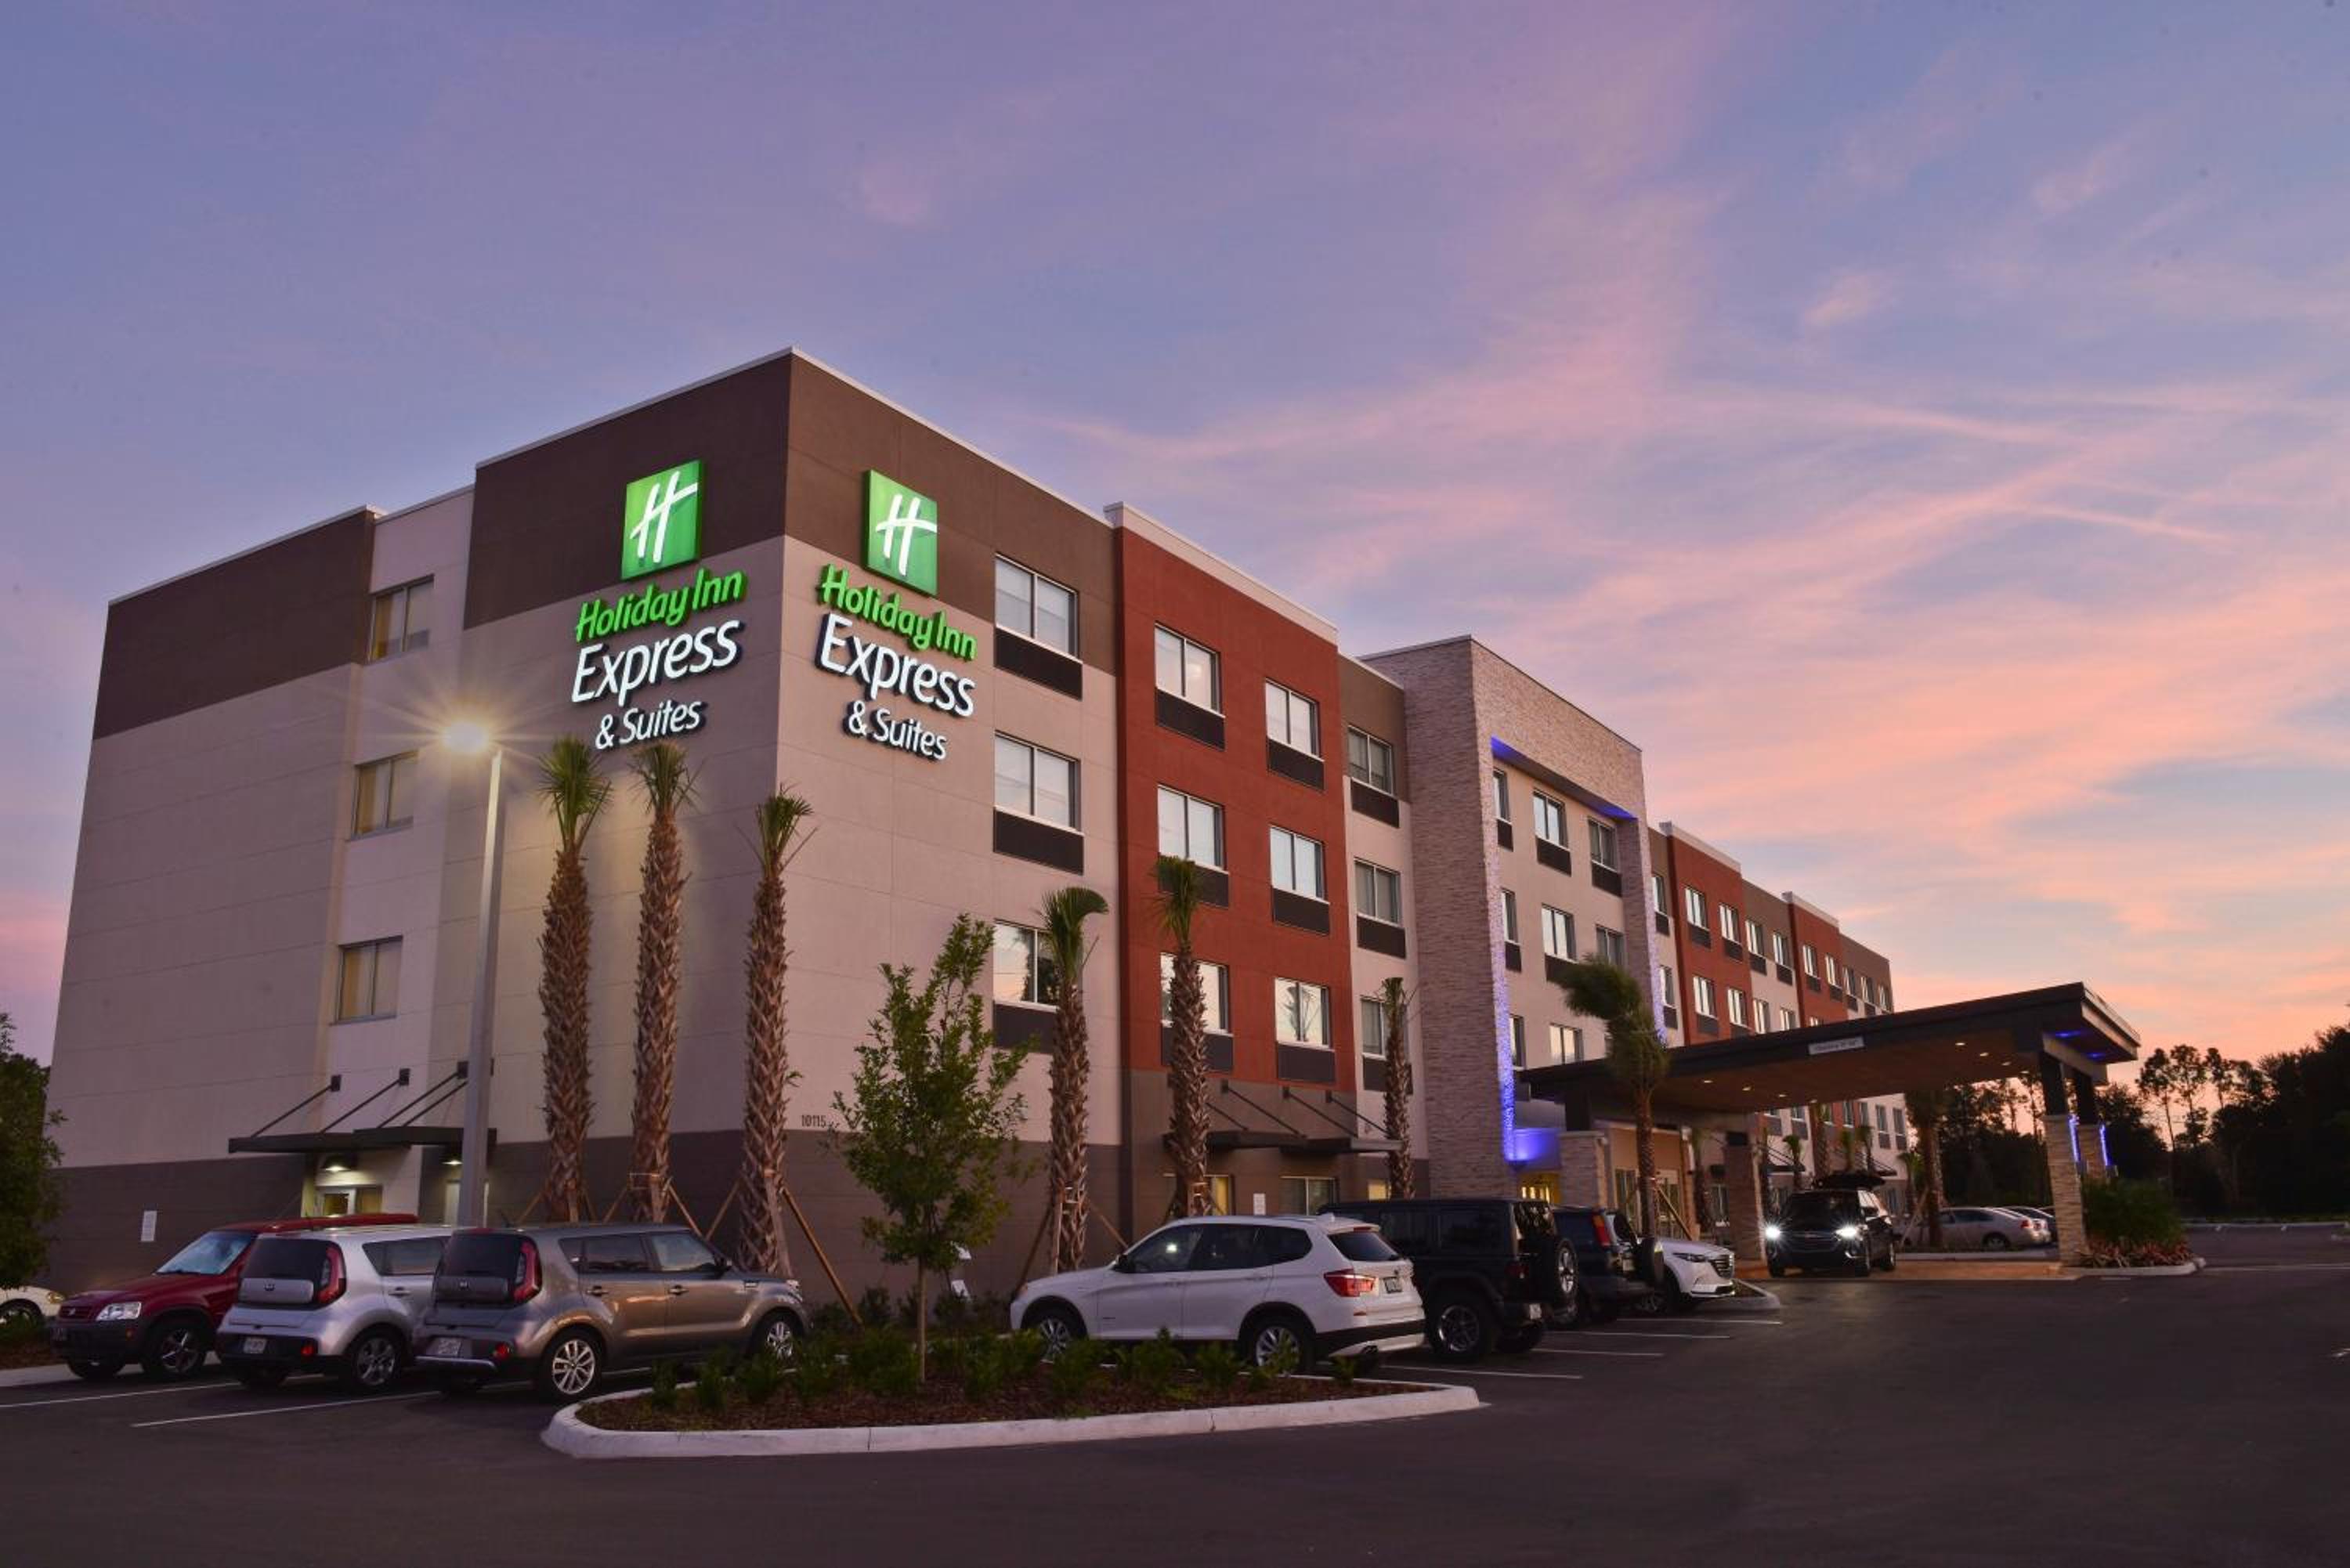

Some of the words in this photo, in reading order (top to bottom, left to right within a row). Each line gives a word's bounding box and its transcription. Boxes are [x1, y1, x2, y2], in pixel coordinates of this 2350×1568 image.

[576, 585, 692, 642] Holiday
[692, 569, 743, 609] Inn
[819, 565, 934, 650] Holiday
[935, 610, 978, 660] Inn
[571, 620, 741, 706] Express
[819, 612, 977, 717] Express
[595, 714, 614, 750] &
[620, 700, 701, 745] Suites
[848, 700, 869, 735] &
[873, 712, 947, 760] Suites
